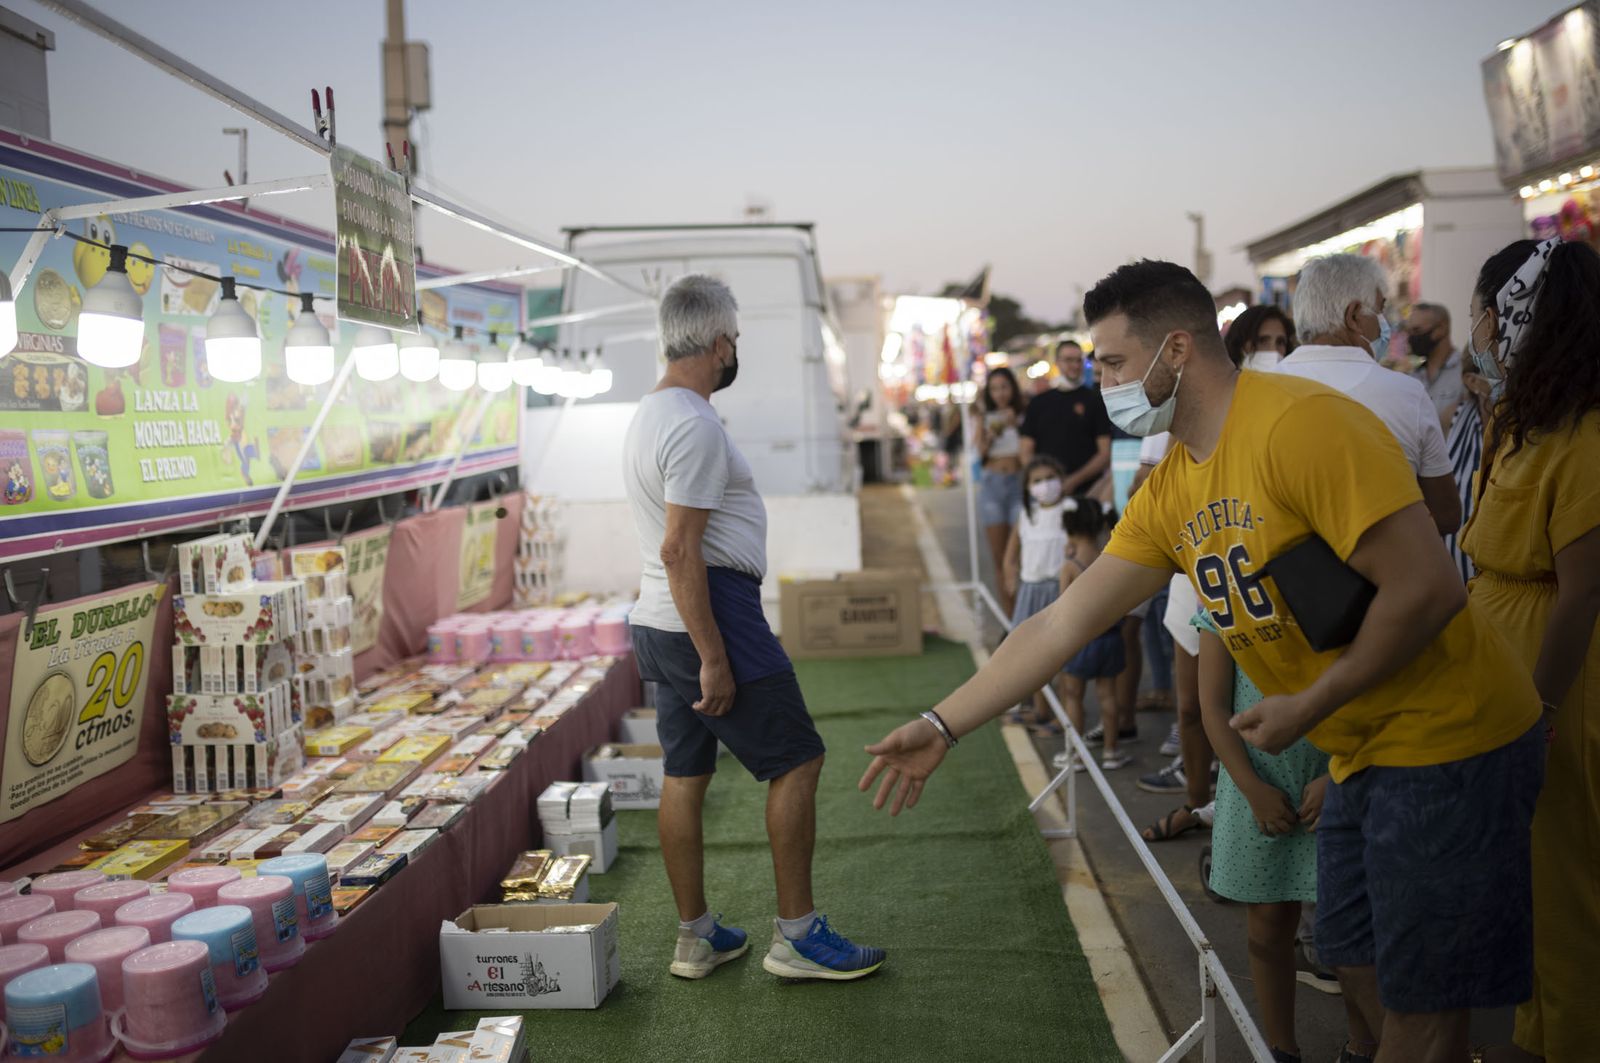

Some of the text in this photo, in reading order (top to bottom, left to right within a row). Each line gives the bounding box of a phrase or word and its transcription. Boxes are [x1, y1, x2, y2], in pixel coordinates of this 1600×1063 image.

[134, 390, 199, 413] LANZA LA
[134, 418, 223, 449] MONEDA HACIA
[139, 455, 197, 483] EL PREMIO
[1195, 543, 1274, 630] 96
[30, 618, 61, 650] EL
[48, 645, 70, 669] La
[74, 628, 122, 660] Tirada
[78, 640, 144, 725] 20
[476, 954, 518, 964] turrones
[467, 980, 525, 992] Artesano
